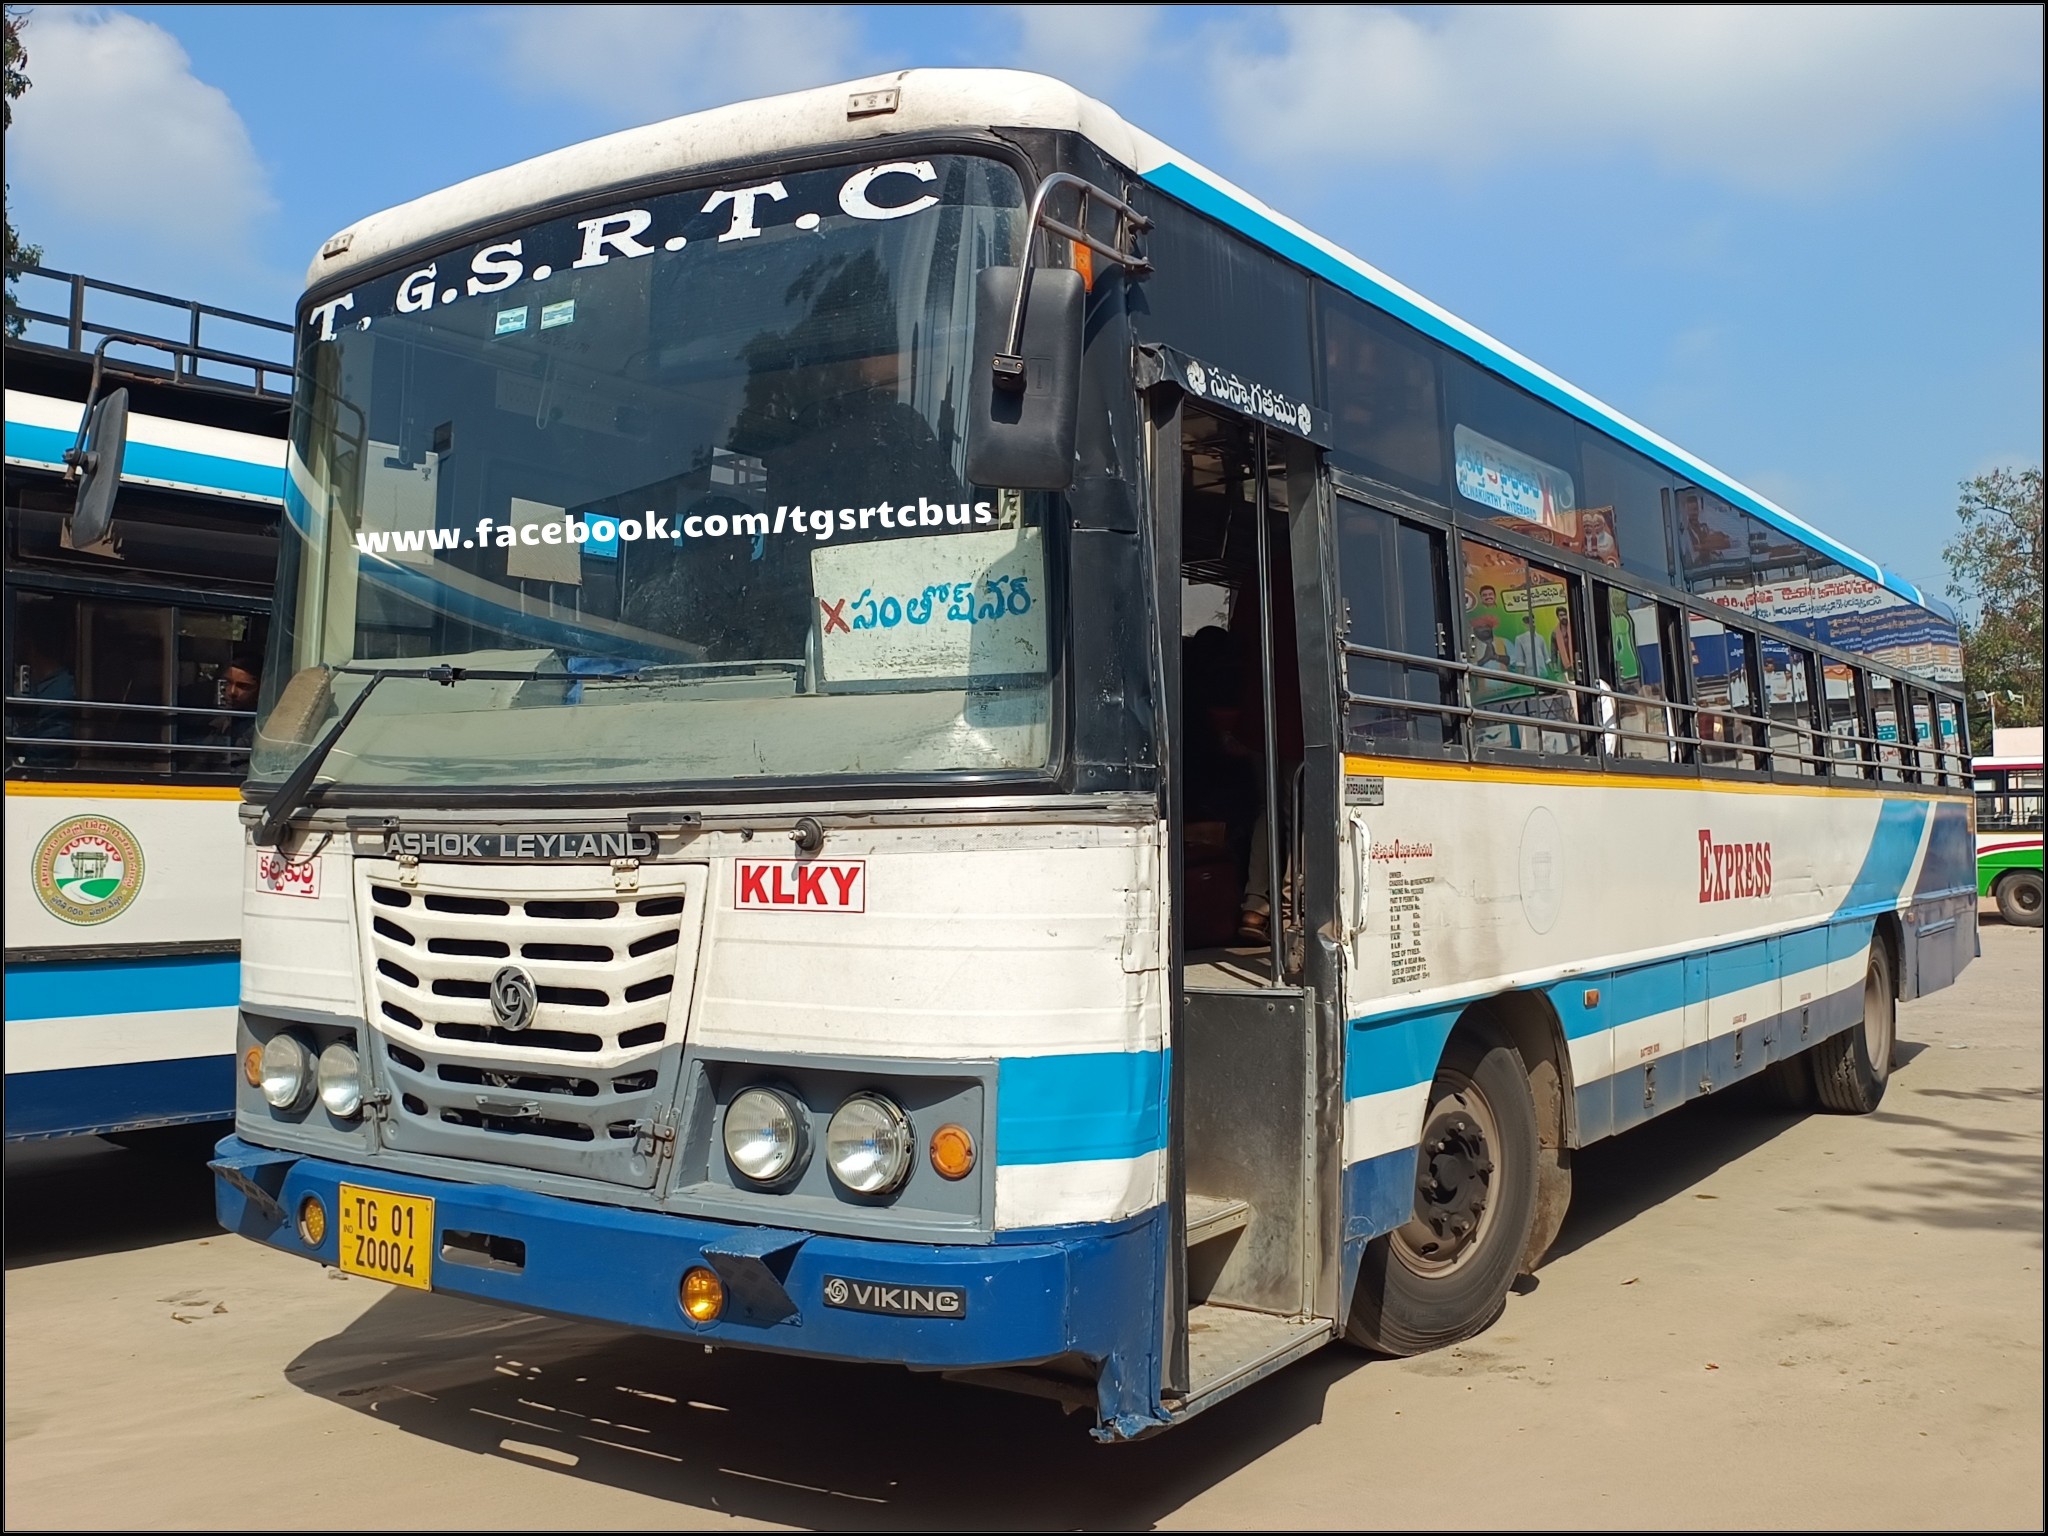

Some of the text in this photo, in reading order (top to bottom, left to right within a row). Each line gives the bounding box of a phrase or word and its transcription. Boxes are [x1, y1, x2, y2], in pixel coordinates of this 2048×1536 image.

[1207, 366, 1298, 427] సుస్వాగతము
[1505, 498, 1537, 521] HYDERABAD
[386, 832, 653, 858] ASHOK LEYLAND
[741, 865, 861, 906] KLKY
[356, 1197, 414, 1239] TG 01
[355, 1234, 414, 1278] Z0004
[852, 1283, 959, 1312] VIKING
